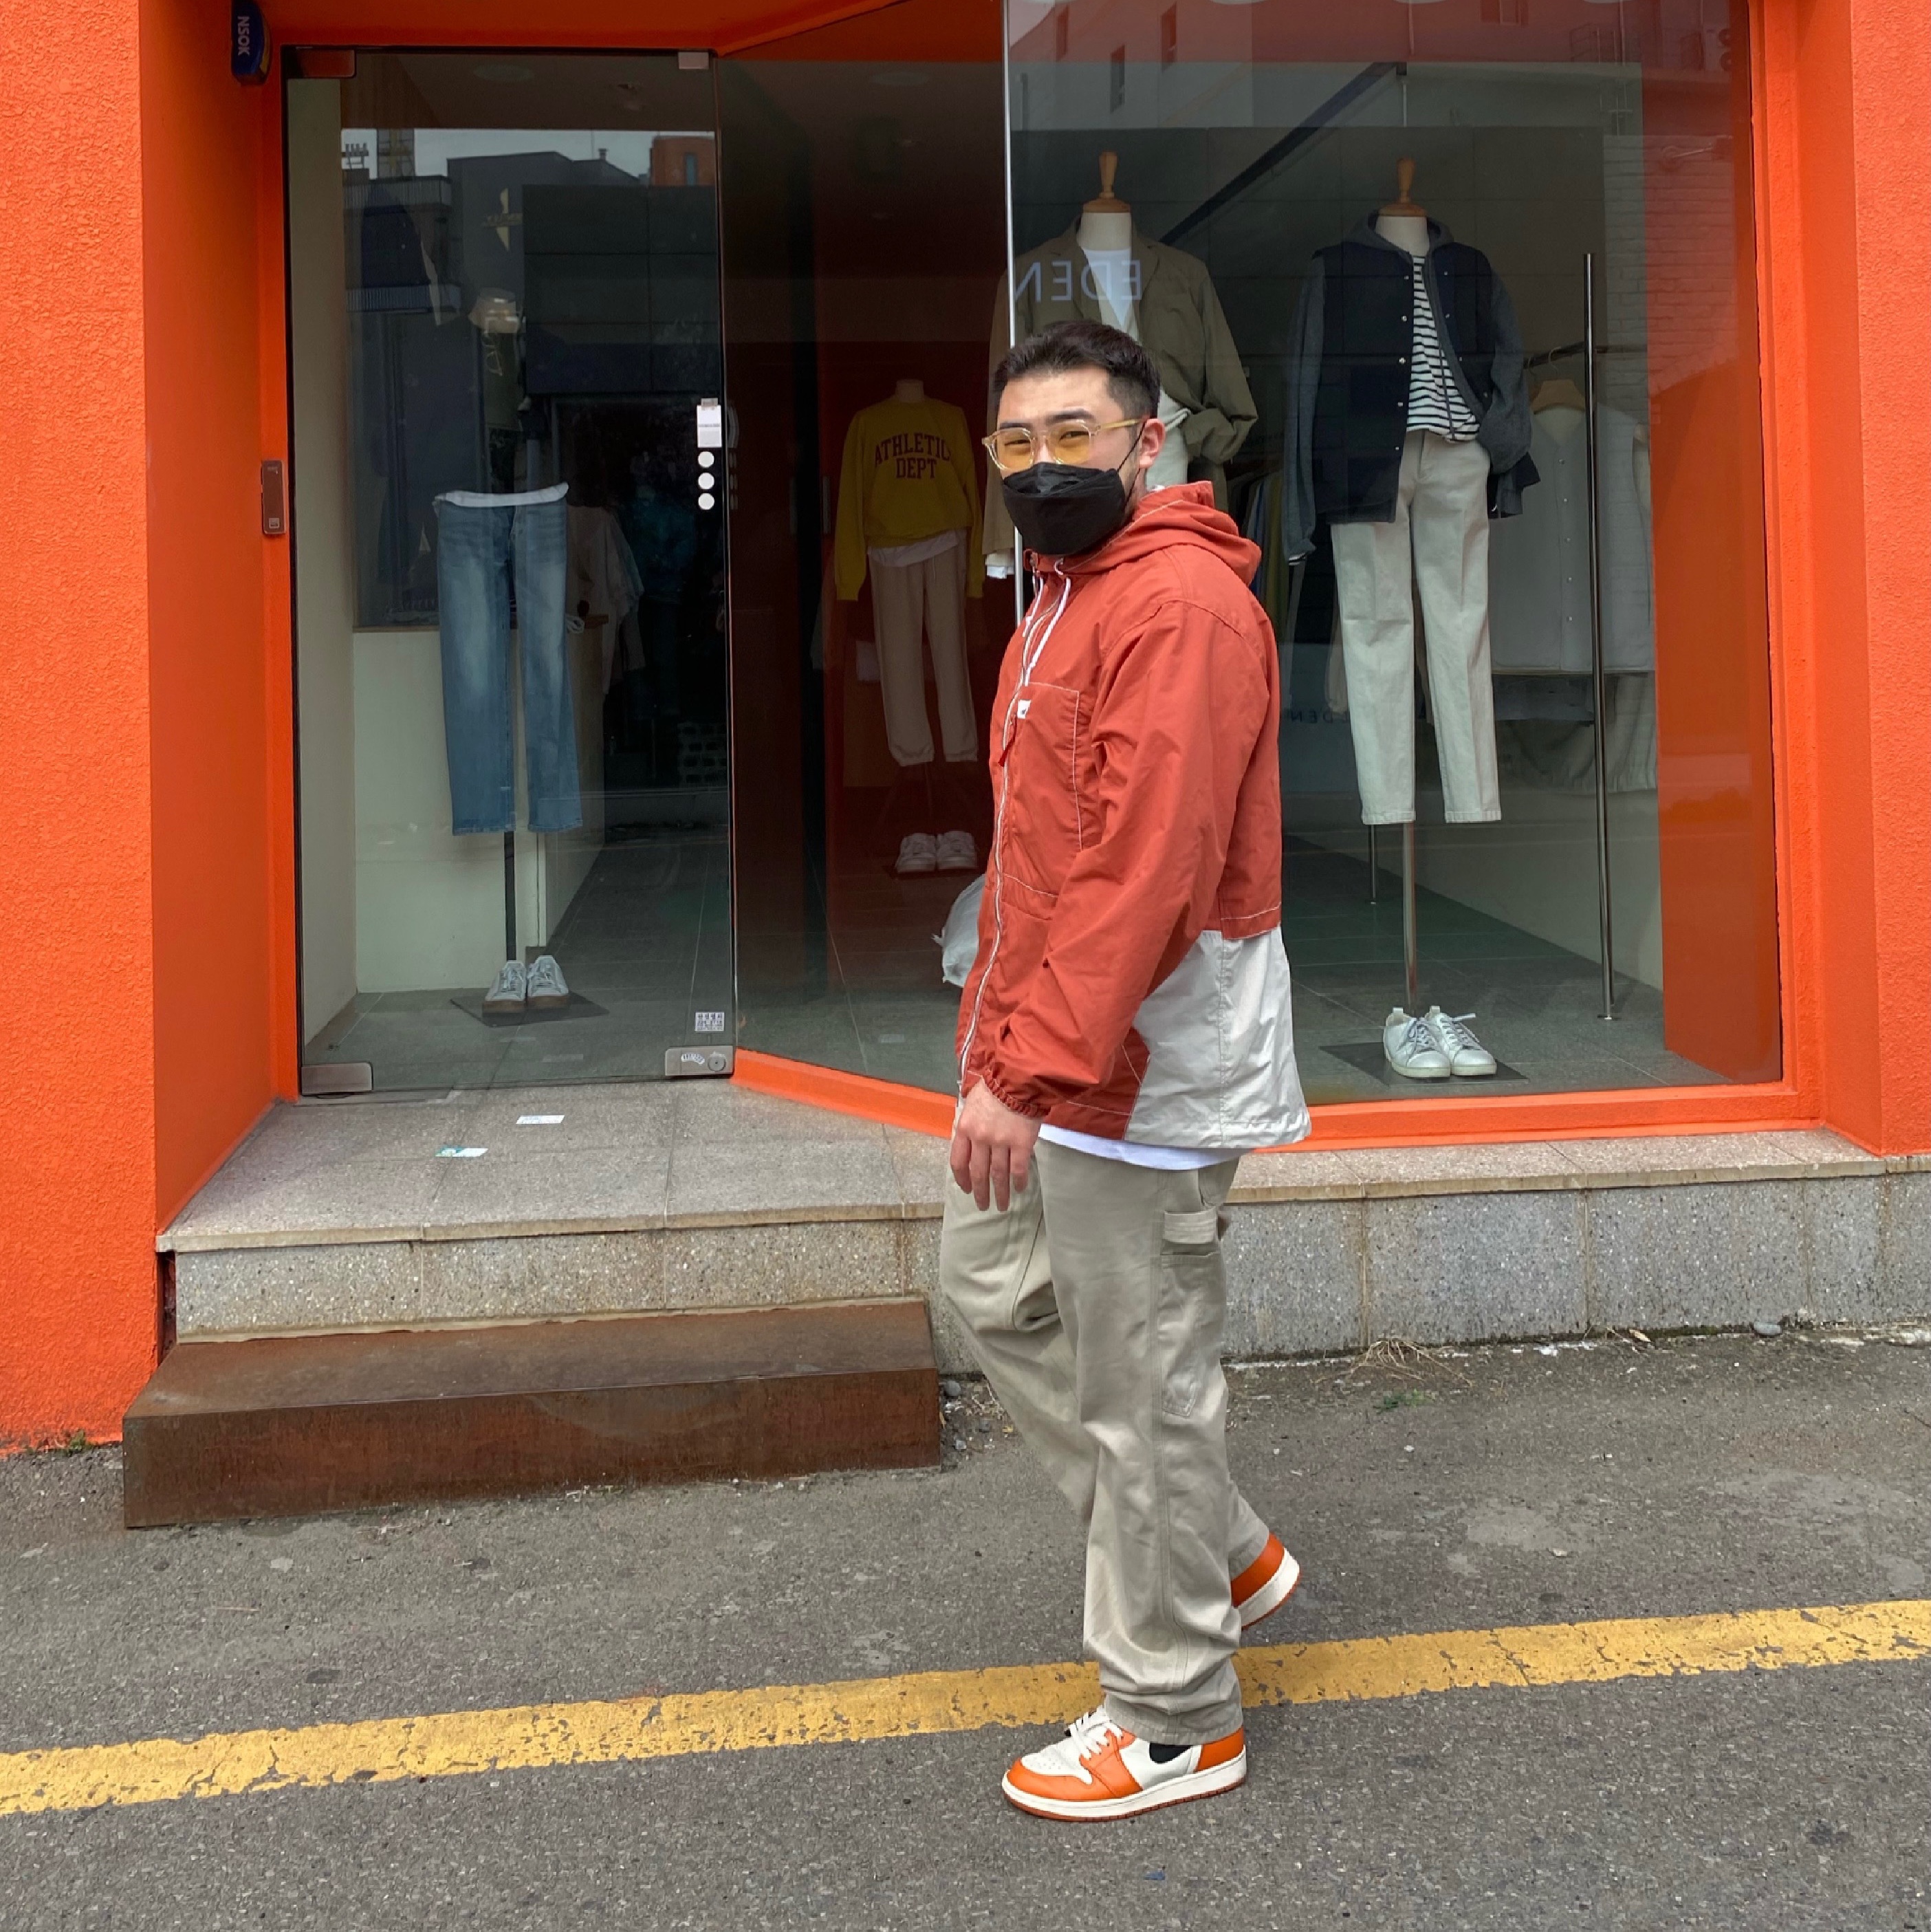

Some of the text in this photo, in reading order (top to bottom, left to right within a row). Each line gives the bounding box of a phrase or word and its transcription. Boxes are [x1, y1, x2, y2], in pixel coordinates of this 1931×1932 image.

[237, 16, 250, 56] NSOK
[875, 432, 952, 468] ATHLETIC
[895, 457, 937, 479] DEPT
